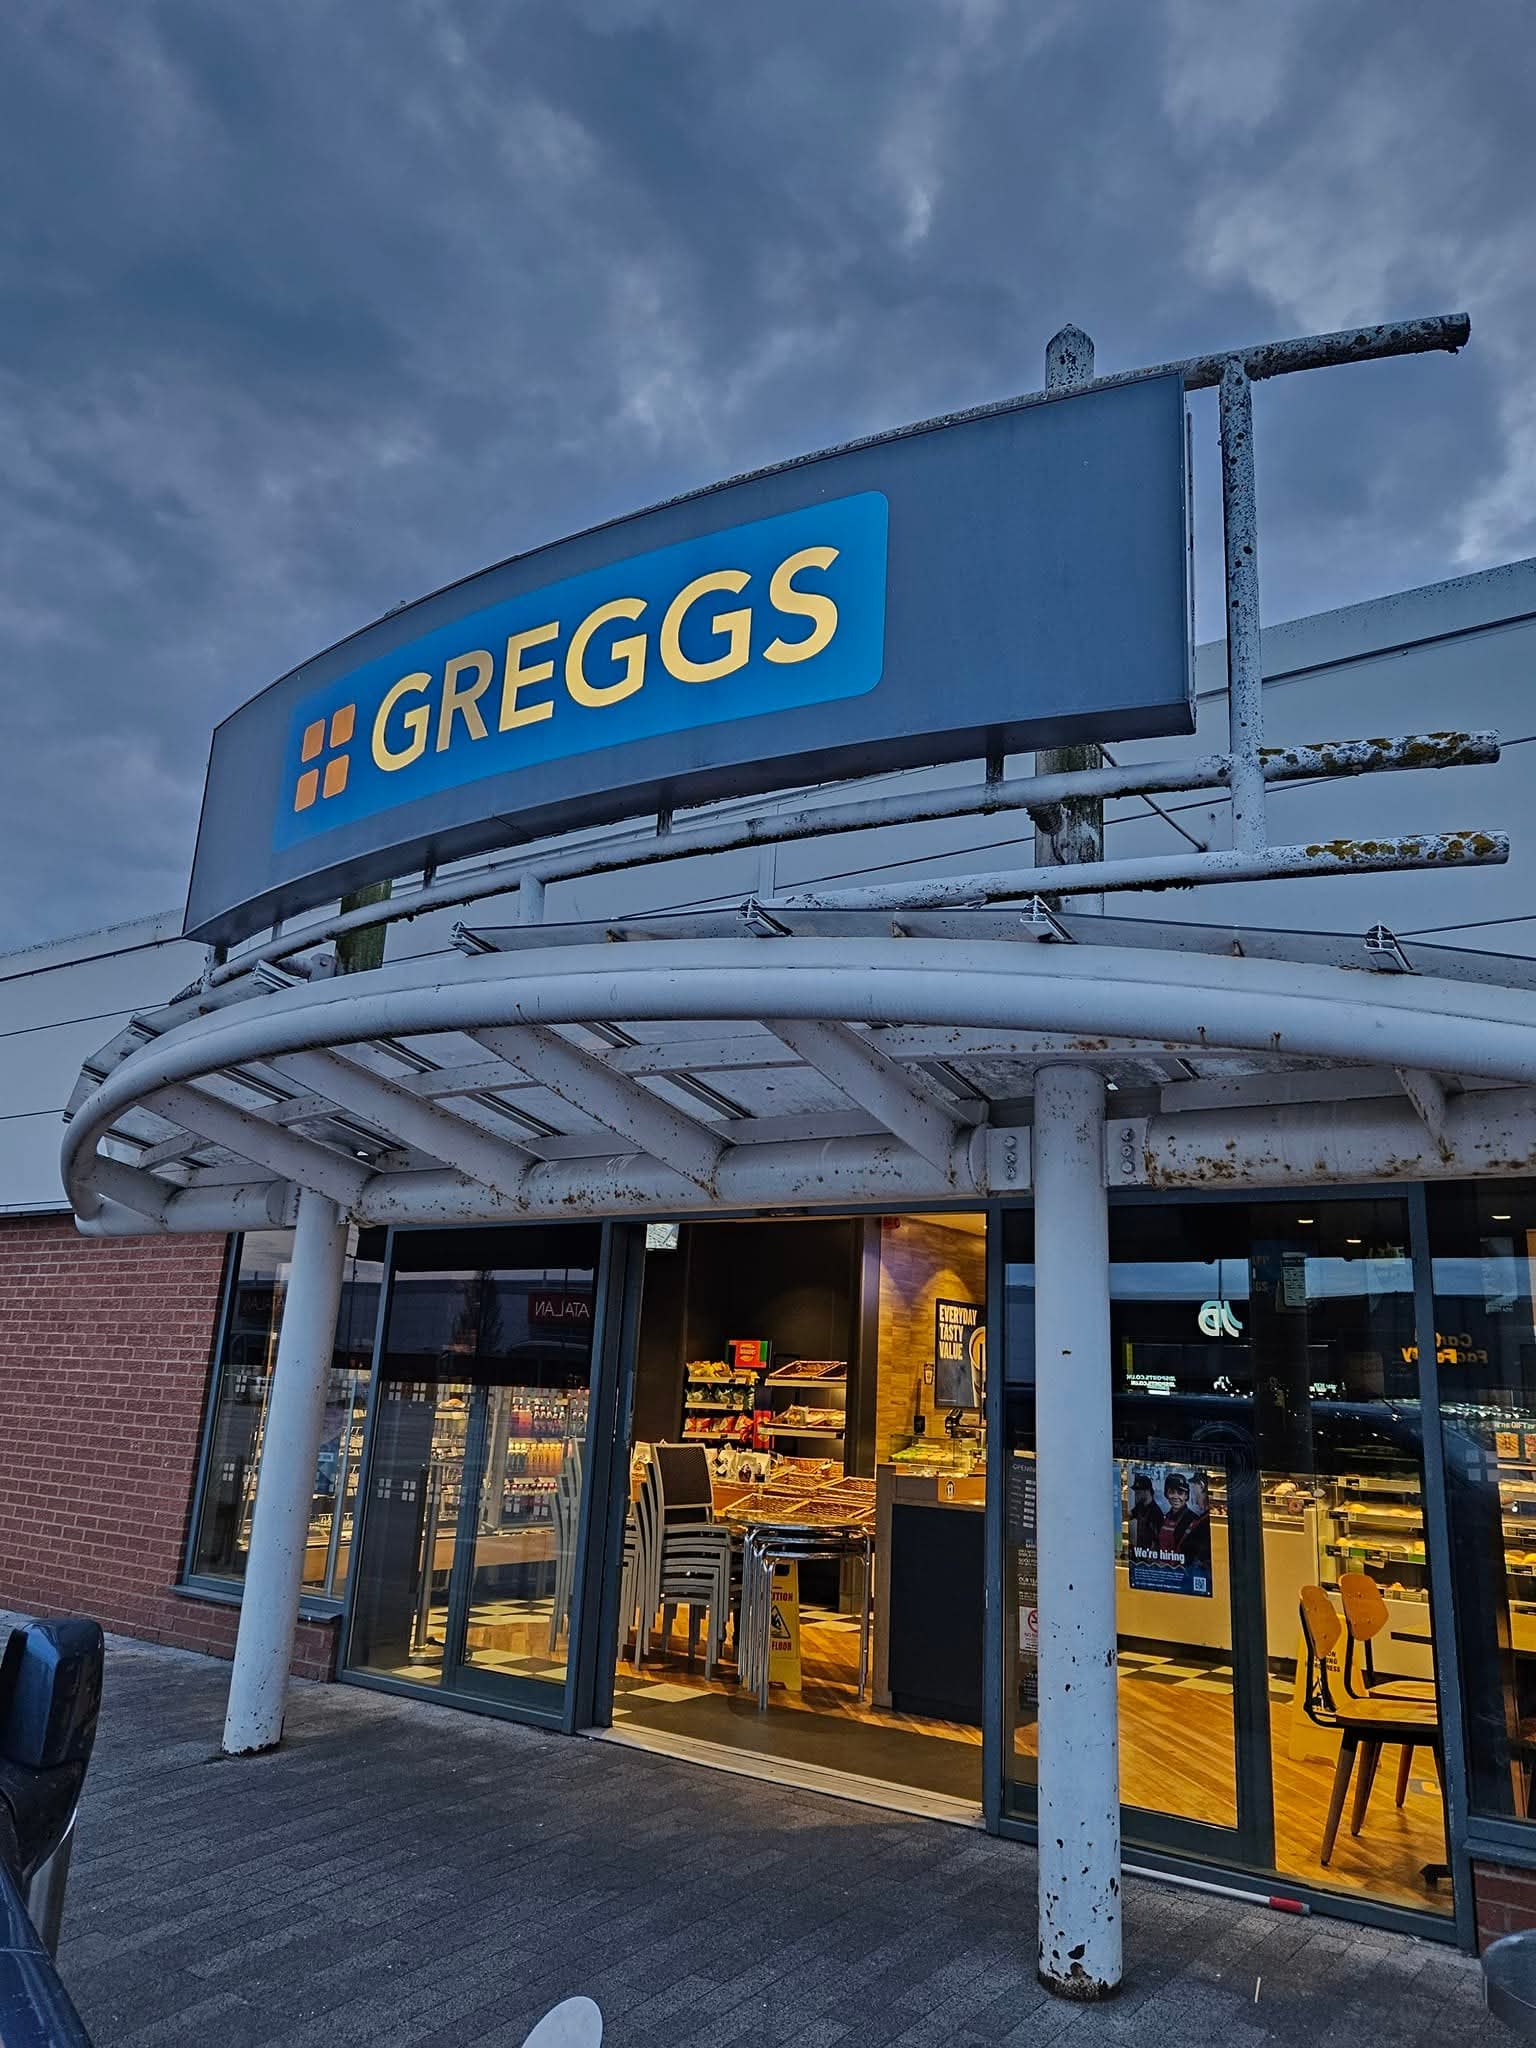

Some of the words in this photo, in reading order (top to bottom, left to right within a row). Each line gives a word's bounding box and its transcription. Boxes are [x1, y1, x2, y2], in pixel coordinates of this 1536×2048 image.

[371, 546, 839, 772] GREGGS
[939, 1304, 977, 1326] EVERYDAY
[939, 1322, 963, 1342] TASTY
[939, 1341, 963, 1360] VALUE
[1134, 1546, 1158, 1559] We're
[1160, 1549, 1185, 1564] hiring
[771, 1641, 792, 1651] FLOOR
